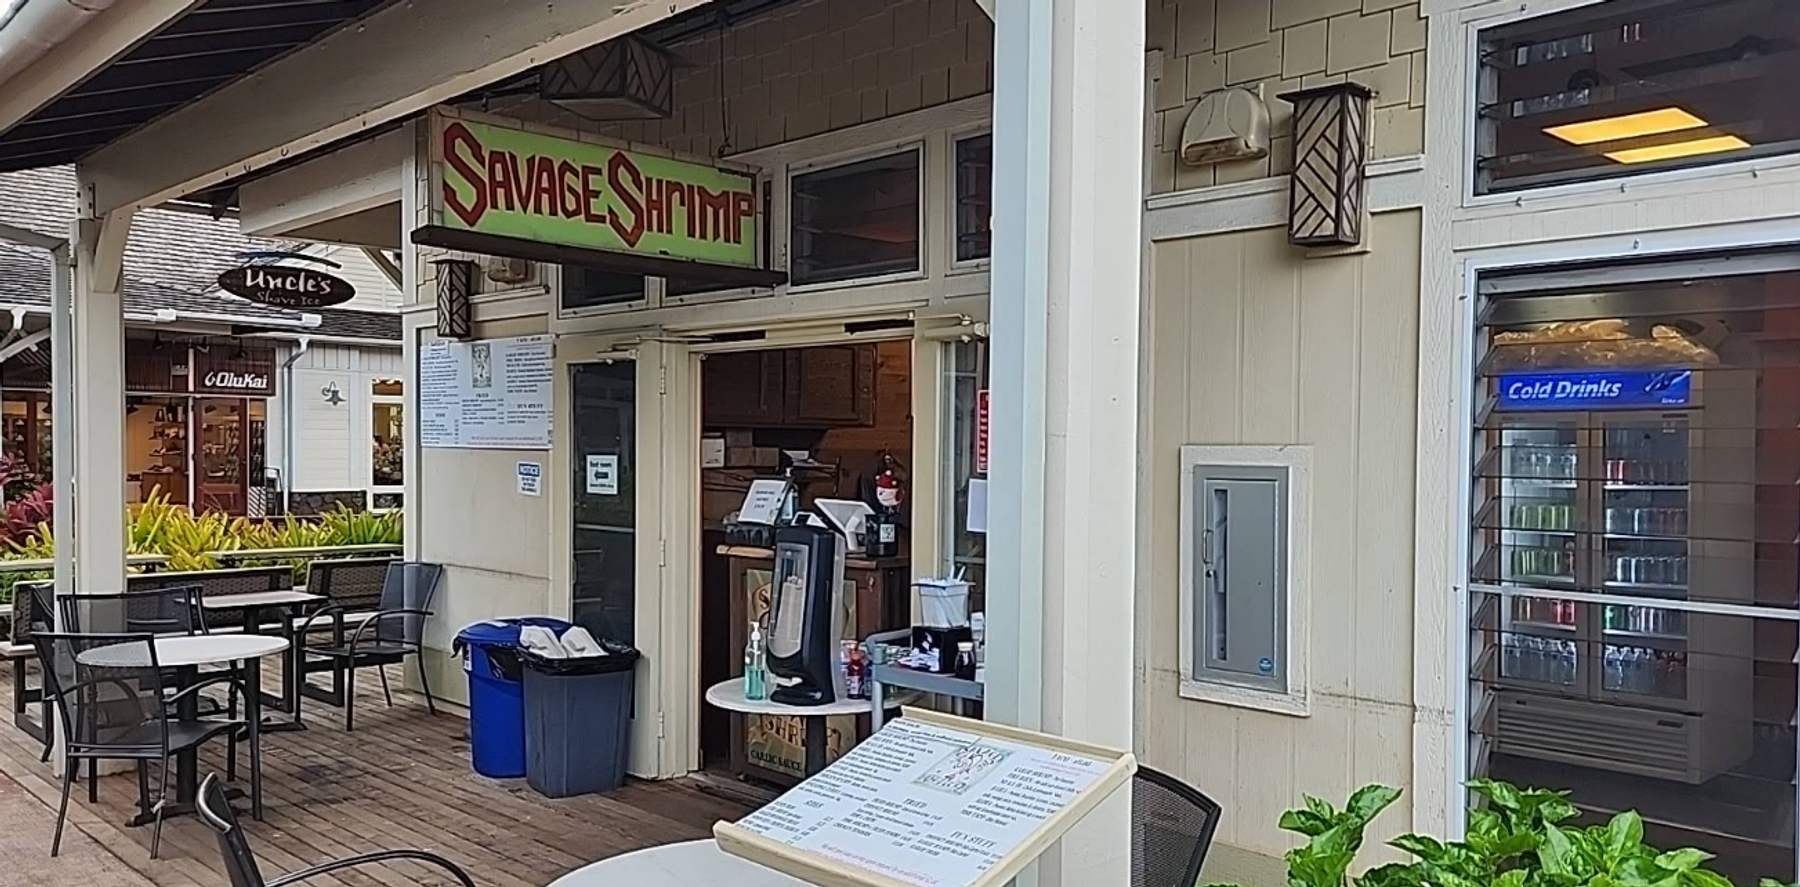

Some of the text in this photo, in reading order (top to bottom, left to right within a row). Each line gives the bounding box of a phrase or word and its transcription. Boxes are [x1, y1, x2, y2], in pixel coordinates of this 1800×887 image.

[443, 122, 607, 228] SAVAGE
[245, 268, 331, 294] Uncle's
[257, 290, 320, 305] Shave Ice
[215, 372, 268, 388] OluKai
[1508, 379, 1622, 399] Cold Drinks
